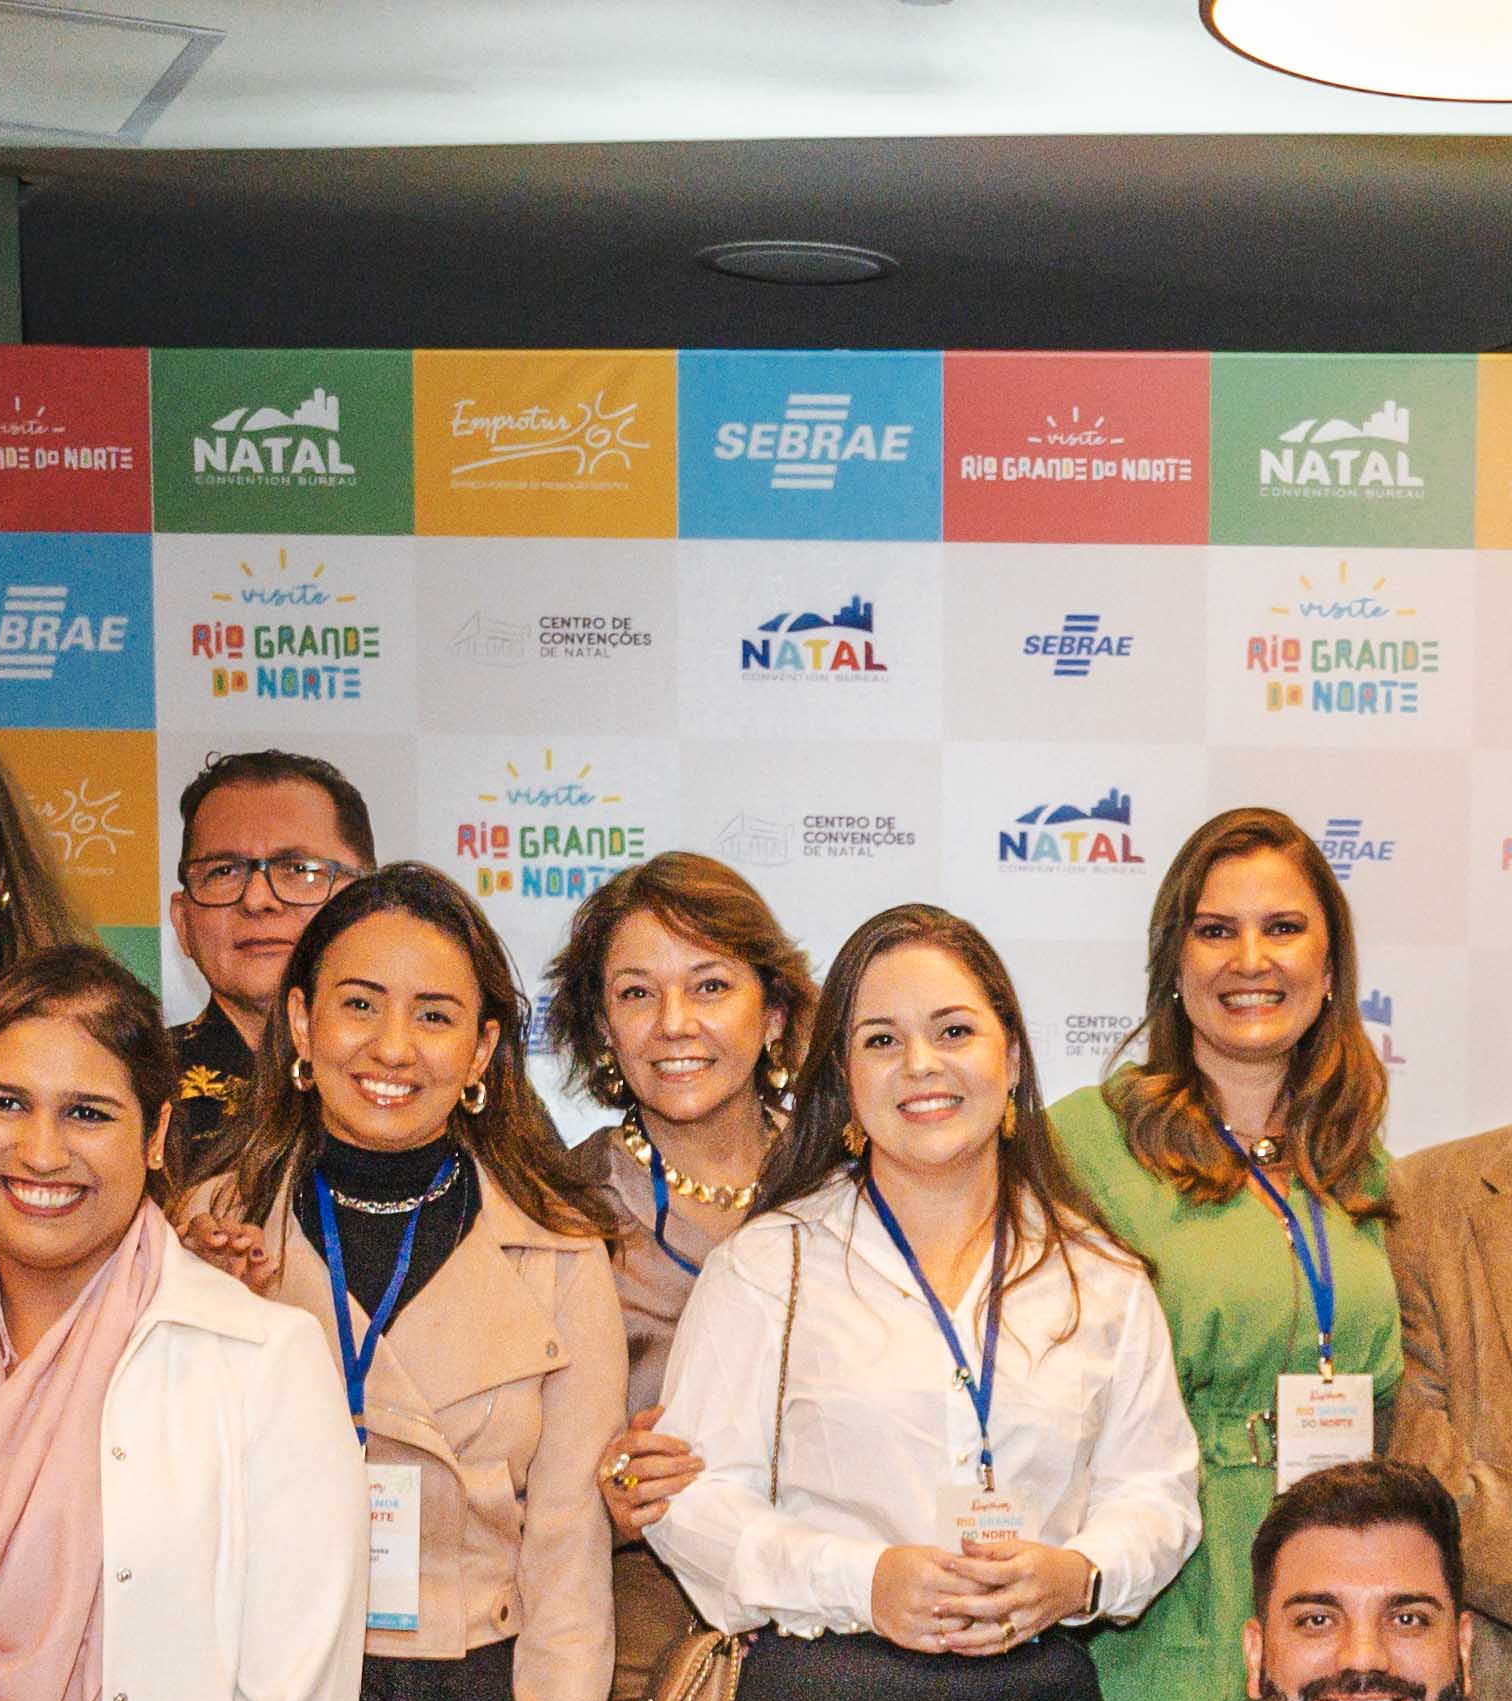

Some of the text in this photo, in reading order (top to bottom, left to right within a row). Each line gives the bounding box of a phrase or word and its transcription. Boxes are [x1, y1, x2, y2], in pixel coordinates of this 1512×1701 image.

[451, 400, 573, 443] Emprotur
[714, 423, 914, 461] SEBRAE
[1046, 429, 1107, 447] visite
[35, 447, 60, 471] DO
[64, 446, 134, 471] NORTE
[193, 437, 356, 474] NATAL
[1259, 448, 1425, 487] NATAL
[193, 474, 358, 488] CONVENTION BUREAU
[1002, 456, 1087, 482] GRANDE
[1091, 457, 1117, 482] DO
[1122, 457, 1192, 482] NORTE
[1259, 487, 1426, 499] CONVENTION BUREAU
[240, 584, 331, 606] visite
[1299, 598, 1390, 620] visite
[539, 616, 632, 630] CENTRO DE
[254, 625, 380, 660] GRANDE
[539, 629, 652, 649] CONVENÇÕES
[1022, 635, 1134, 657] SEBRAE
[539, 647, 611, 659] DE NATAL
[741, 639, 888, 672] NATAL
[1310, 639, 1439, 673] GRANDE
[212, 666, 361, 700] DO NORTE
[1266, 680, 1419, 714] DO NORTE
[506, 784, 596, 807] visite
[803, 816, 896, 830] CENTRO DE
[519, 826, 645, 860] GRANDE
[803, 829, 916, 848] CONVENÇÕES
[999, 831, 1145, 863] NATAL
[803, 847, 875, 858] DE NATAL
[477, 868, 513, 897] DO
[1066, 1015, 1133, 1028] CENTRO
